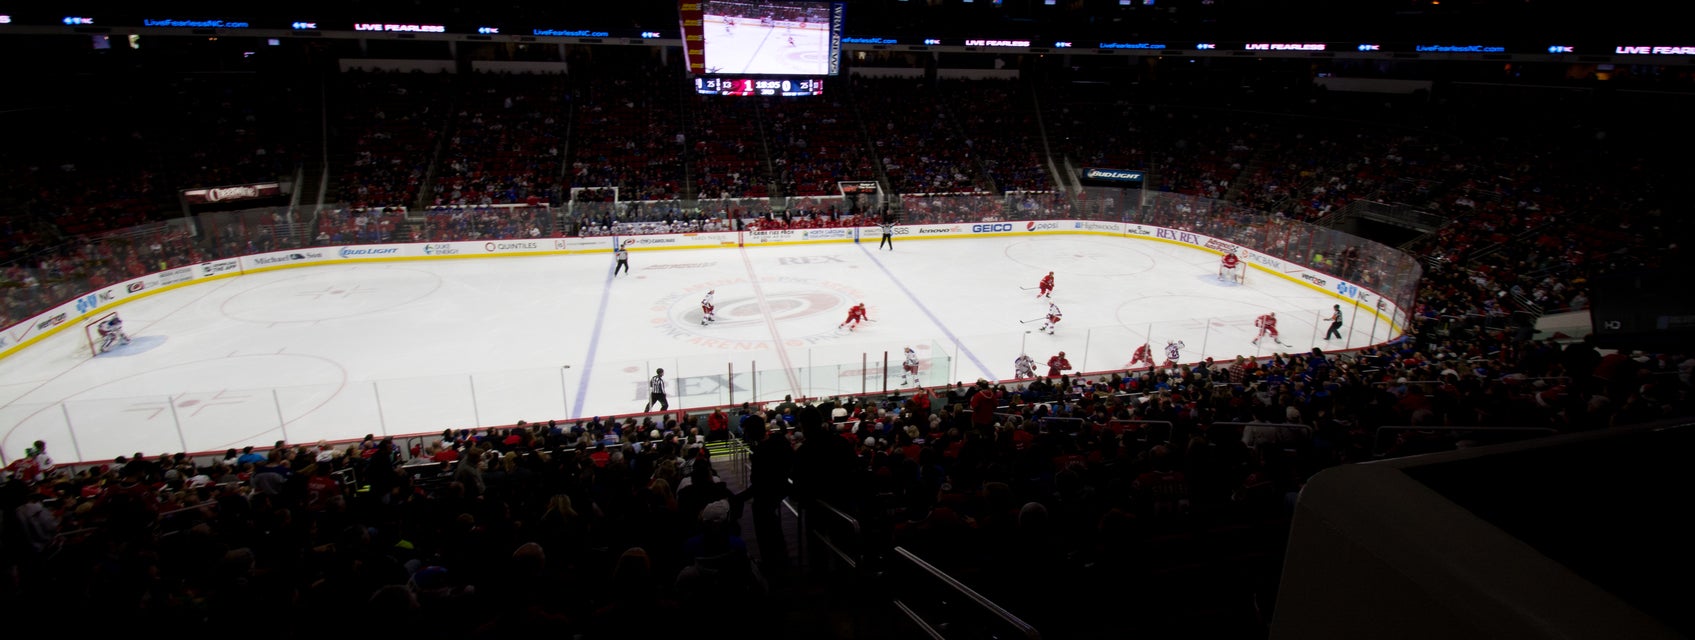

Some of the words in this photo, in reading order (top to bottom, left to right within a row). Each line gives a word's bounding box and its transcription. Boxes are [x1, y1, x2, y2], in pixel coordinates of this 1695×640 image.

[354, 23, 383, 31] LIVE
[384, 24, 445, 33] FEARLESS
[1615, 46, 1651, 54] LIVE
[1092, 170, 1112, 178] BUD
[972, 223, 1013, 233] GEICO
[1037, 222, 1059, 231] pepsi
[1156, 228, 1178, 240] REX
[1179, 231, 1201, 245] REX
[366, 247, 399, 255] LIGHT
[497, 242, 537, 250] QUINTILES
[254, 254, 290, 265] Michael
[778, 254, 845, 266] REX
[1302, 272, 1327, 287] verizon
